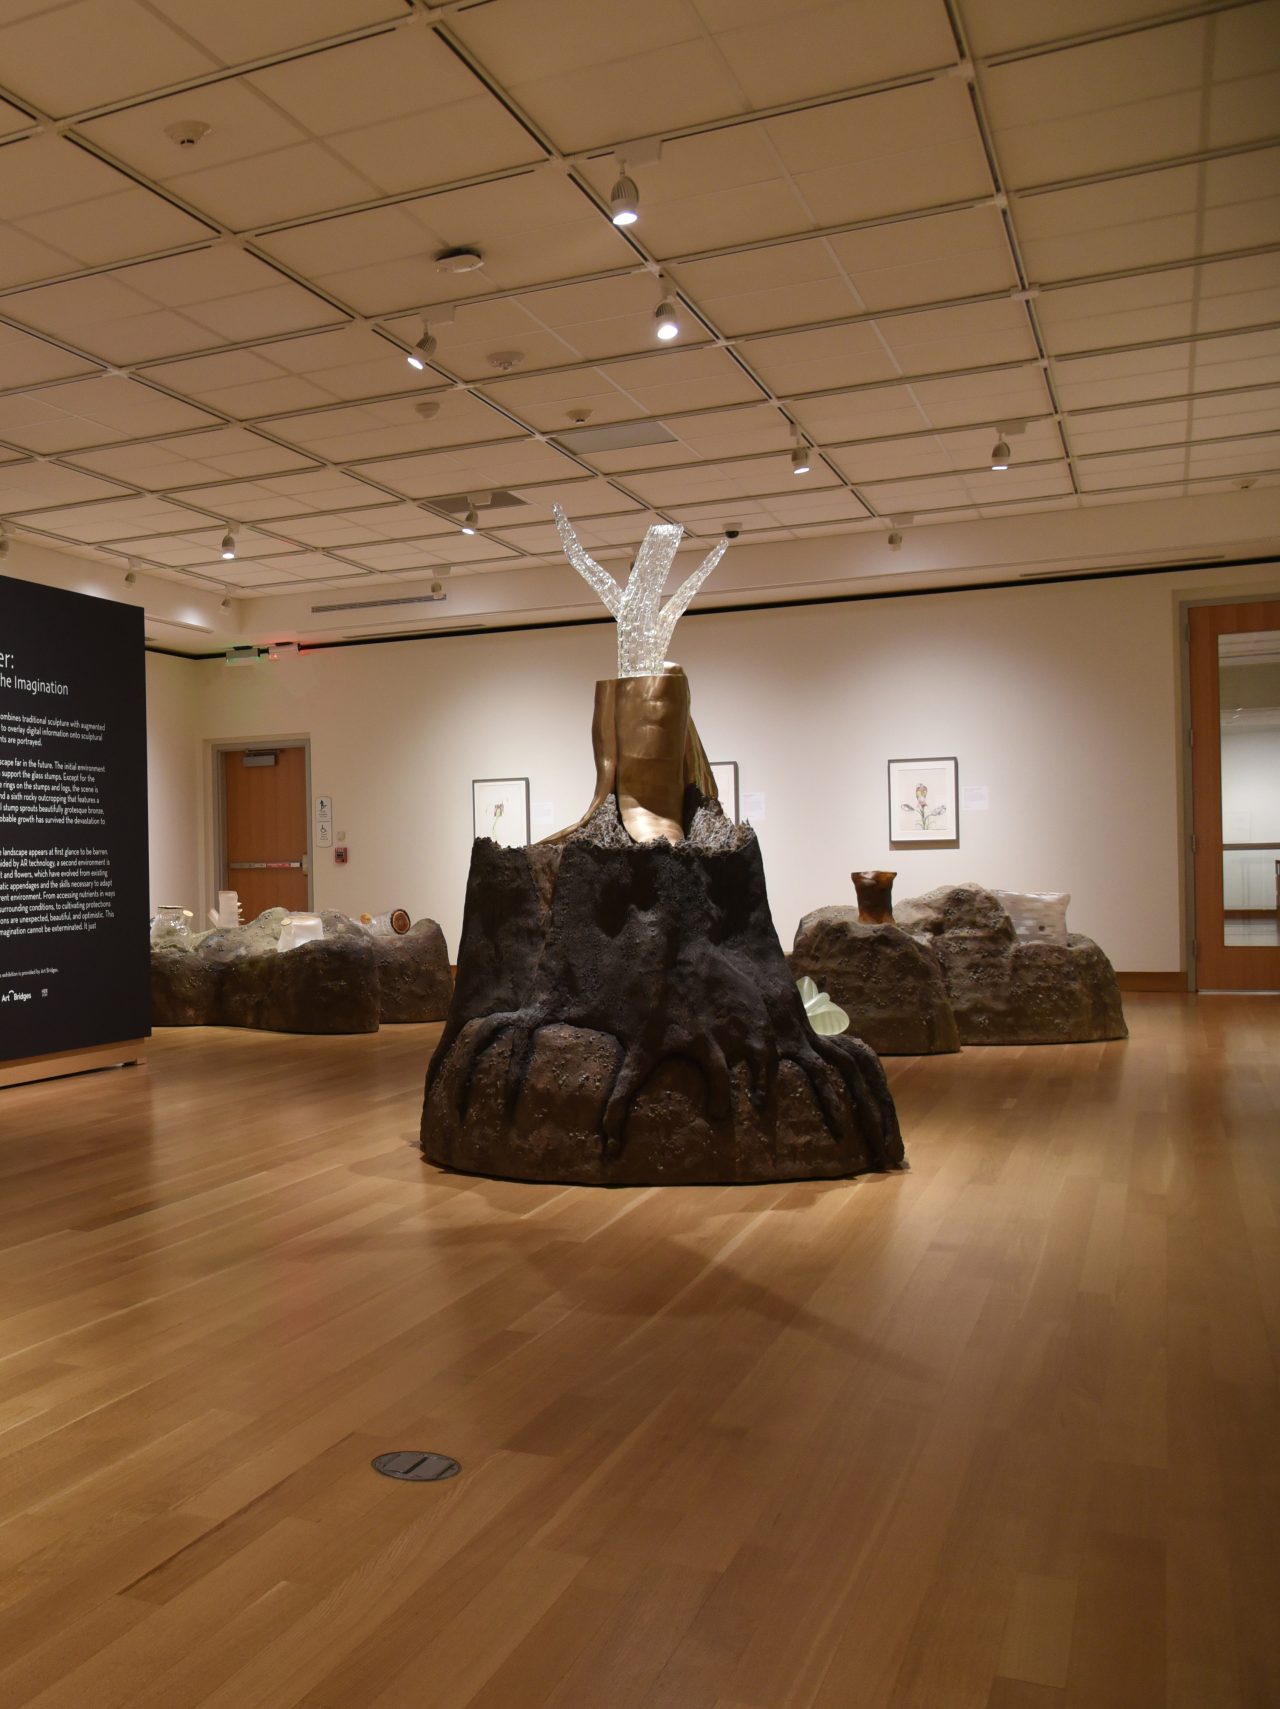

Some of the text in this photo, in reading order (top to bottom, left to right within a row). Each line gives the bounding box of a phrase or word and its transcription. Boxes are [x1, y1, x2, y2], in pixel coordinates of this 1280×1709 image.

[14, 676, 69, 699] Imagination
[1, 994, 10, 1002] Art
[13, 992, 32, 1001] Bridges
